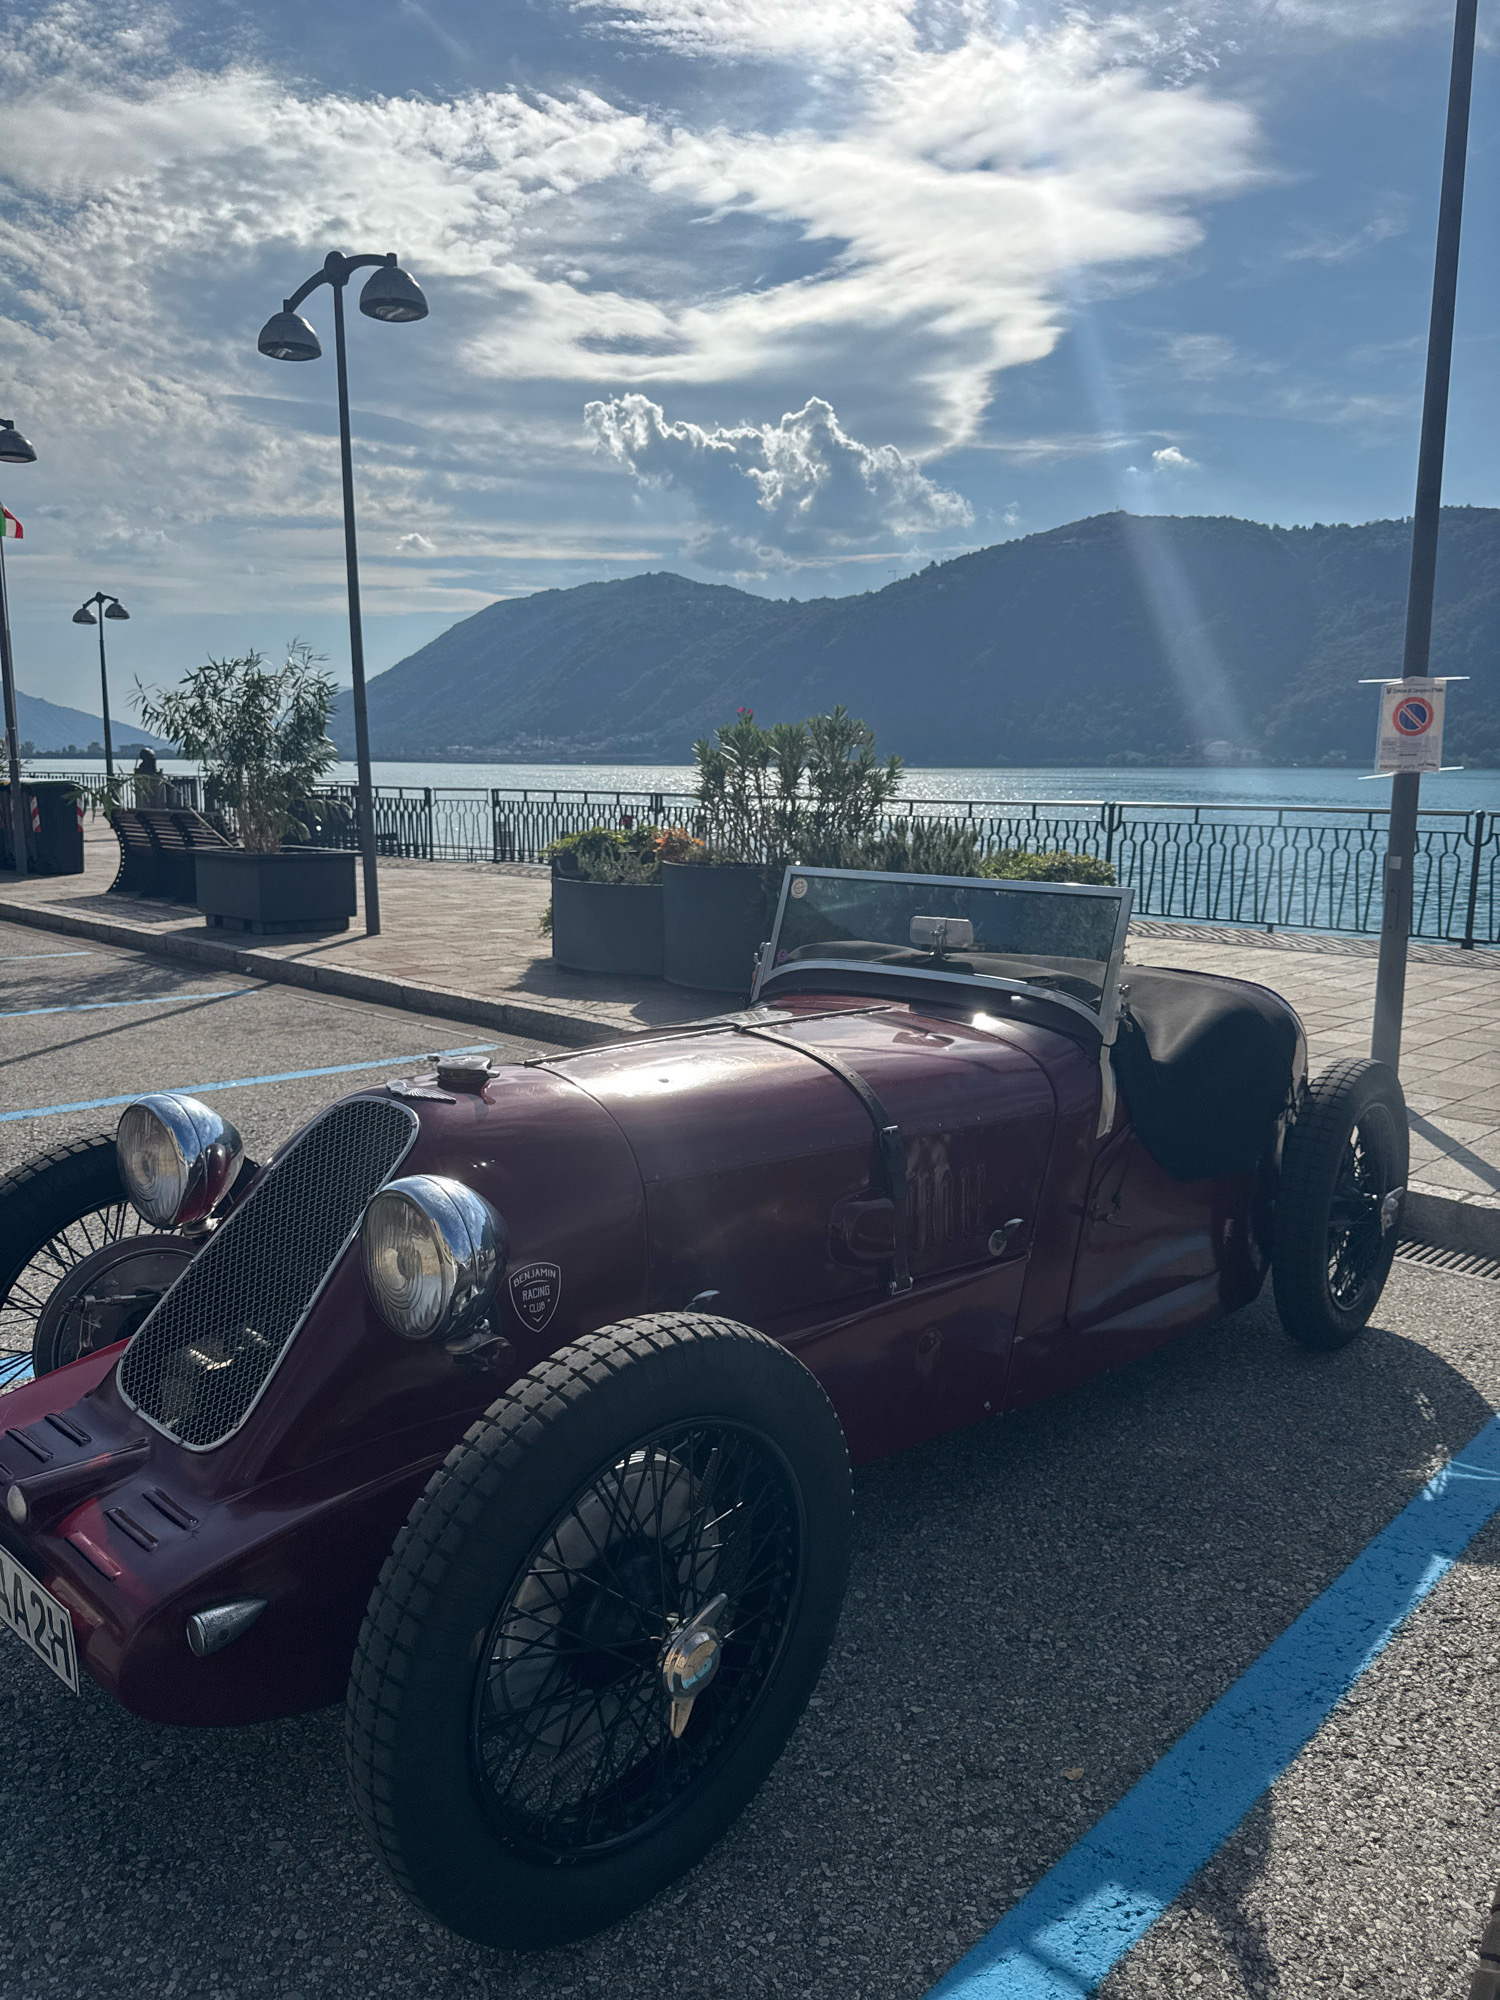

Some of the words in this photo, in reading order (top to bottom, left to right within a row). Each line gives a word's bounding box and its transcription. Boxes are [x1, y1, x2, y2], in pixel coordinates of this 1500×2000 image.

[513, 1268, 557, 1288] BENJAMIN
[522, 1285, 551, 1301] RACING
[529, 1301, 546, 1313] CLUB
